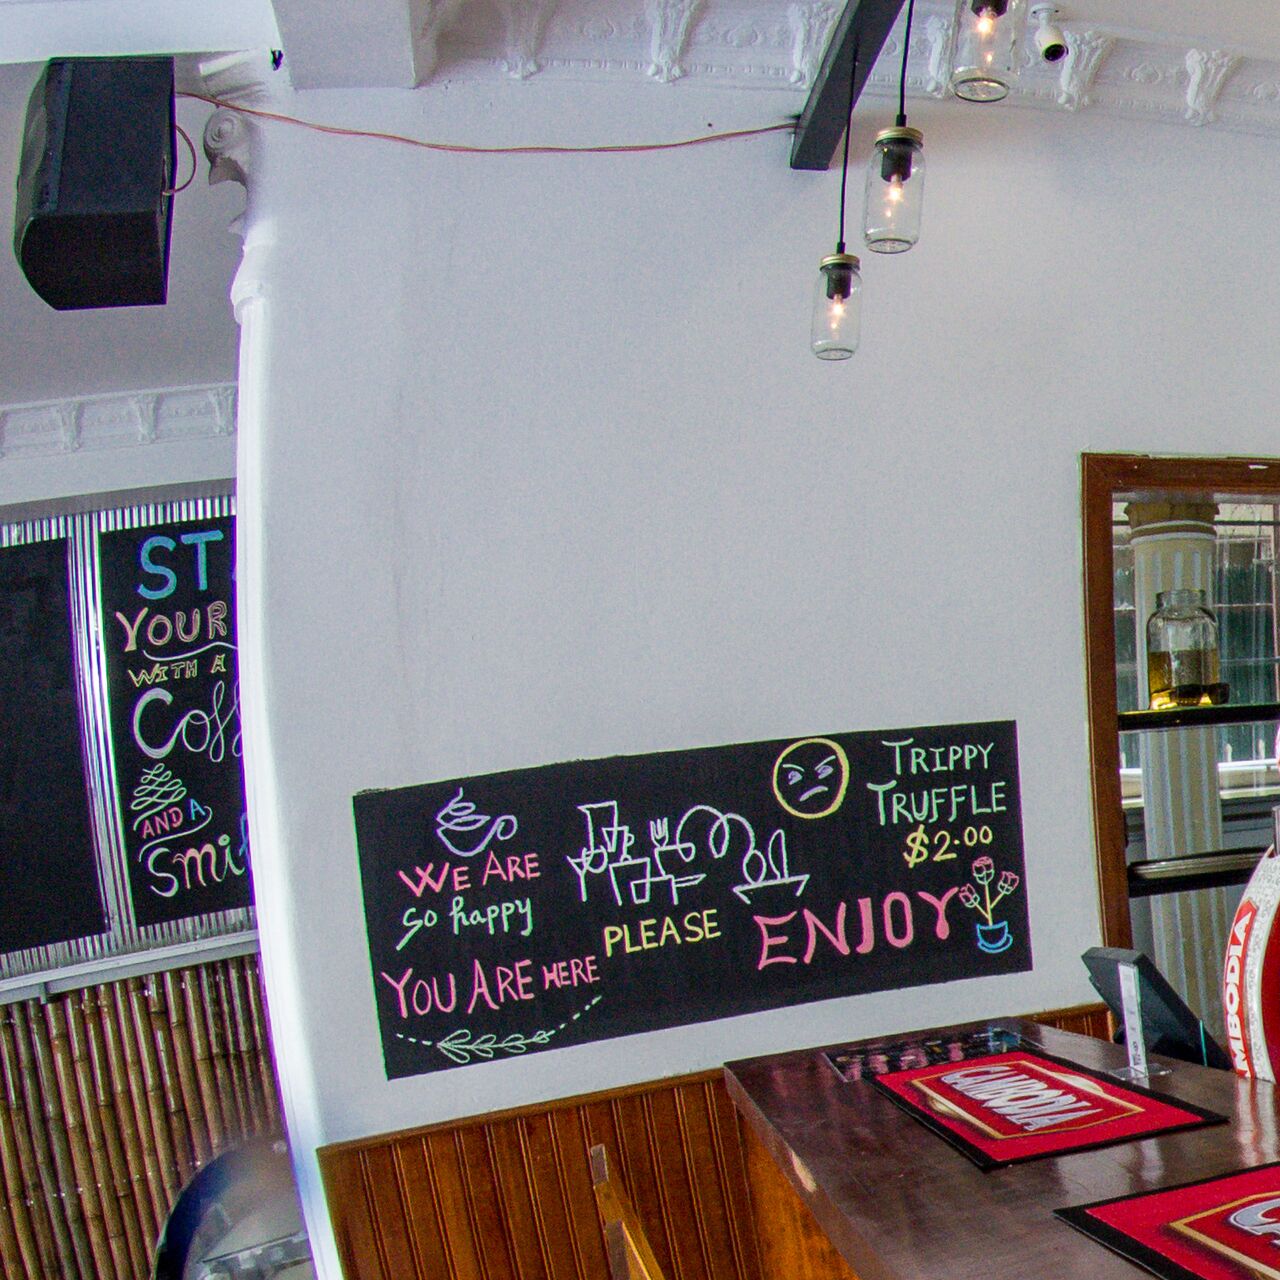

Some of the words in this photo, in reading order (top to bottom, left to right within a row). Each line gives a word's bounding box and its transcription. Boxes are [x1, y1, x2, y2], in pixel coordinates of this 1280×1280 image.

[137, 530, 237, 601] ST
[117, 600, 228, 653] YOUR
[128, 660, 198, 688] WITH
[210, 654, 226, 674] A
[882, 738, 994, 778] TRIPPY
[141, 808, 183, 839] AND
[189, 799, 206, 820] A
[867, 781, 1007, 825] TRUFFLE
[149, 813, 249, 898] Smi
[903, 825, 993, 869] $2.00
[398, 862, 472, 898] WE
[483, 851, 541, 887] ARE
[449, 896, 533, 936] happy
[604, 909, 722, 958] PLEASE
[754, 886, 958, 971] ENJOY
[382, 964, 456, 1020] YOU
[467, 959, 533, 1015] ARE
[541, 953, 600, 991] HERE
[940, 1065, 1104, 1131] CAMBODIA
